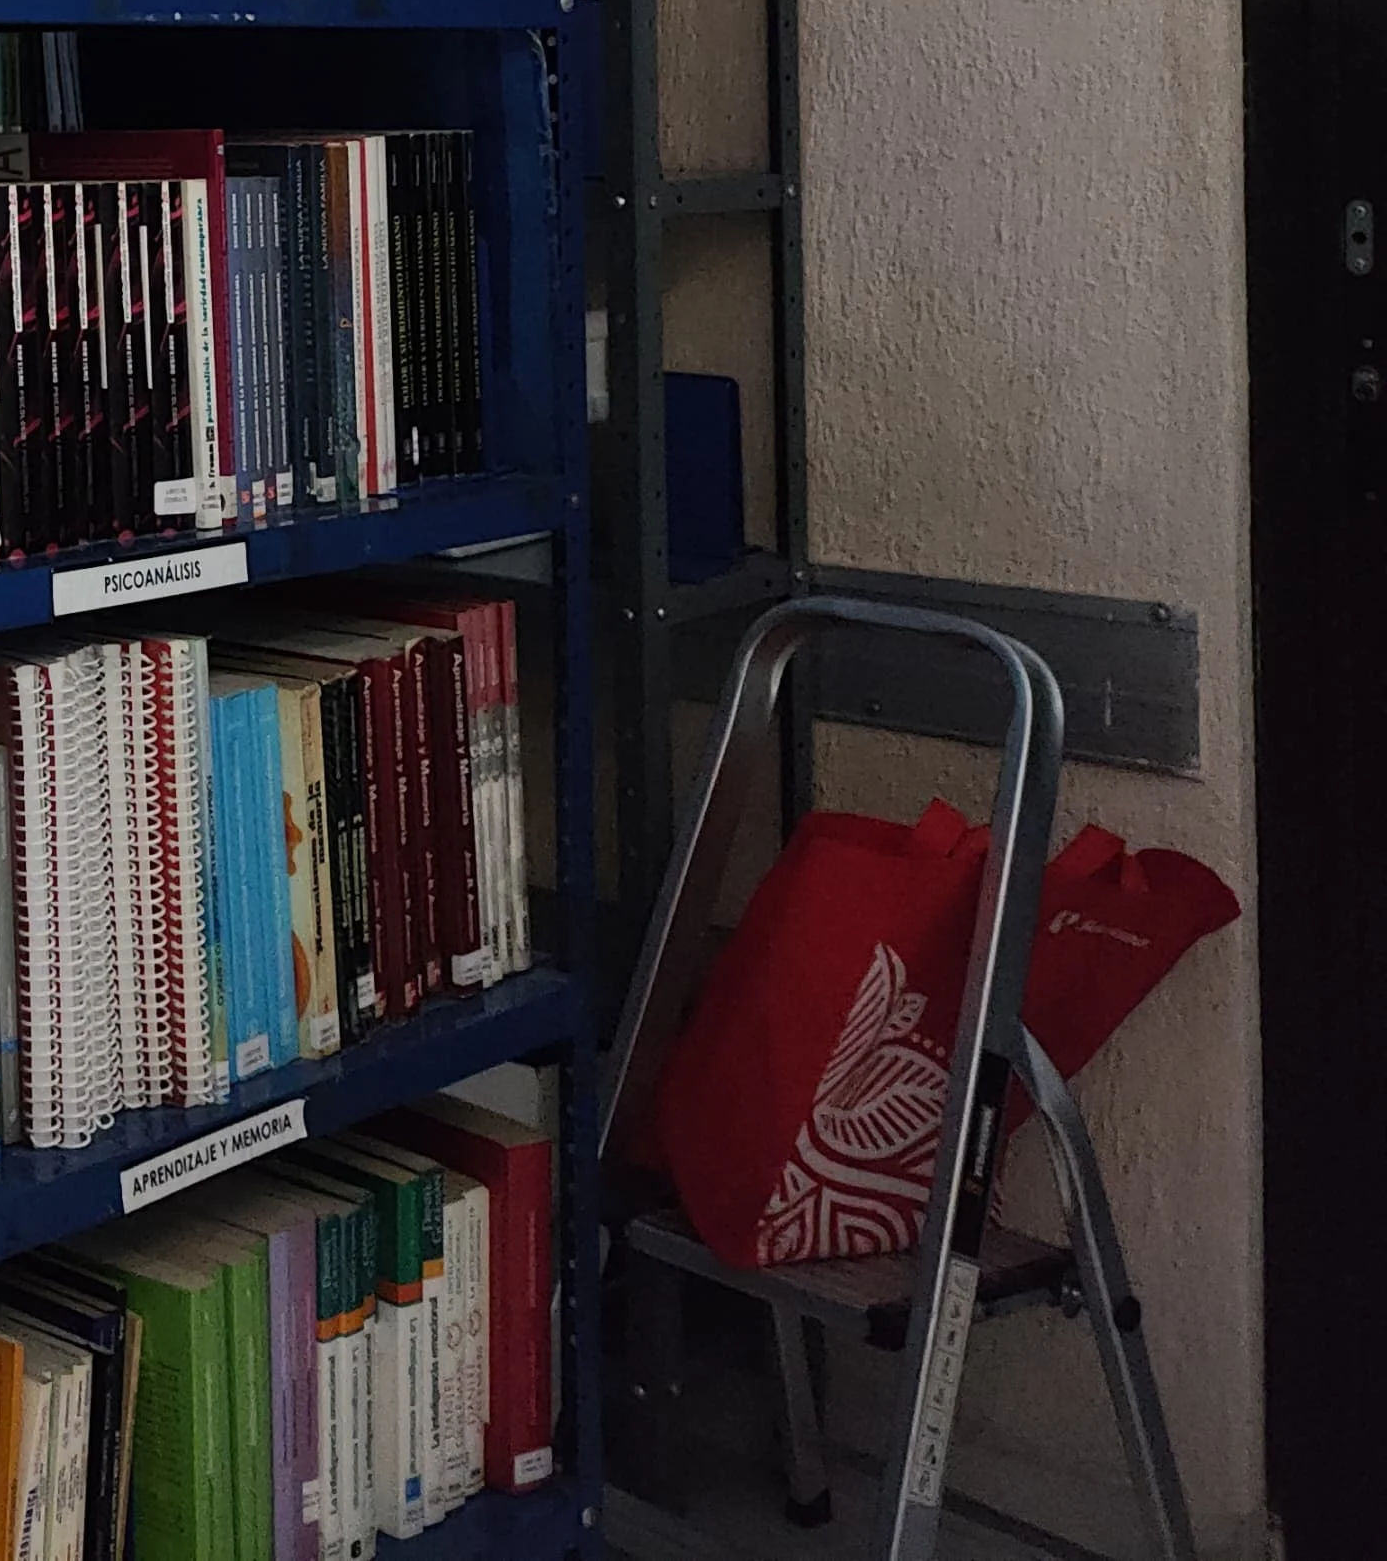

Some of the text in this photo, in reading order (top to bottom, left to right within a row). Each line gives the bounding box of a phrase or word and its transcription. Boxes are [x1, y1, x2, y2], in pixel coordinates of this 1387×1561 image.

[103, 561, 202, 594] PSICOANÁLISIS
[131, 1116, 293, 1198] APRENDIZAJE Y MEMORIA
